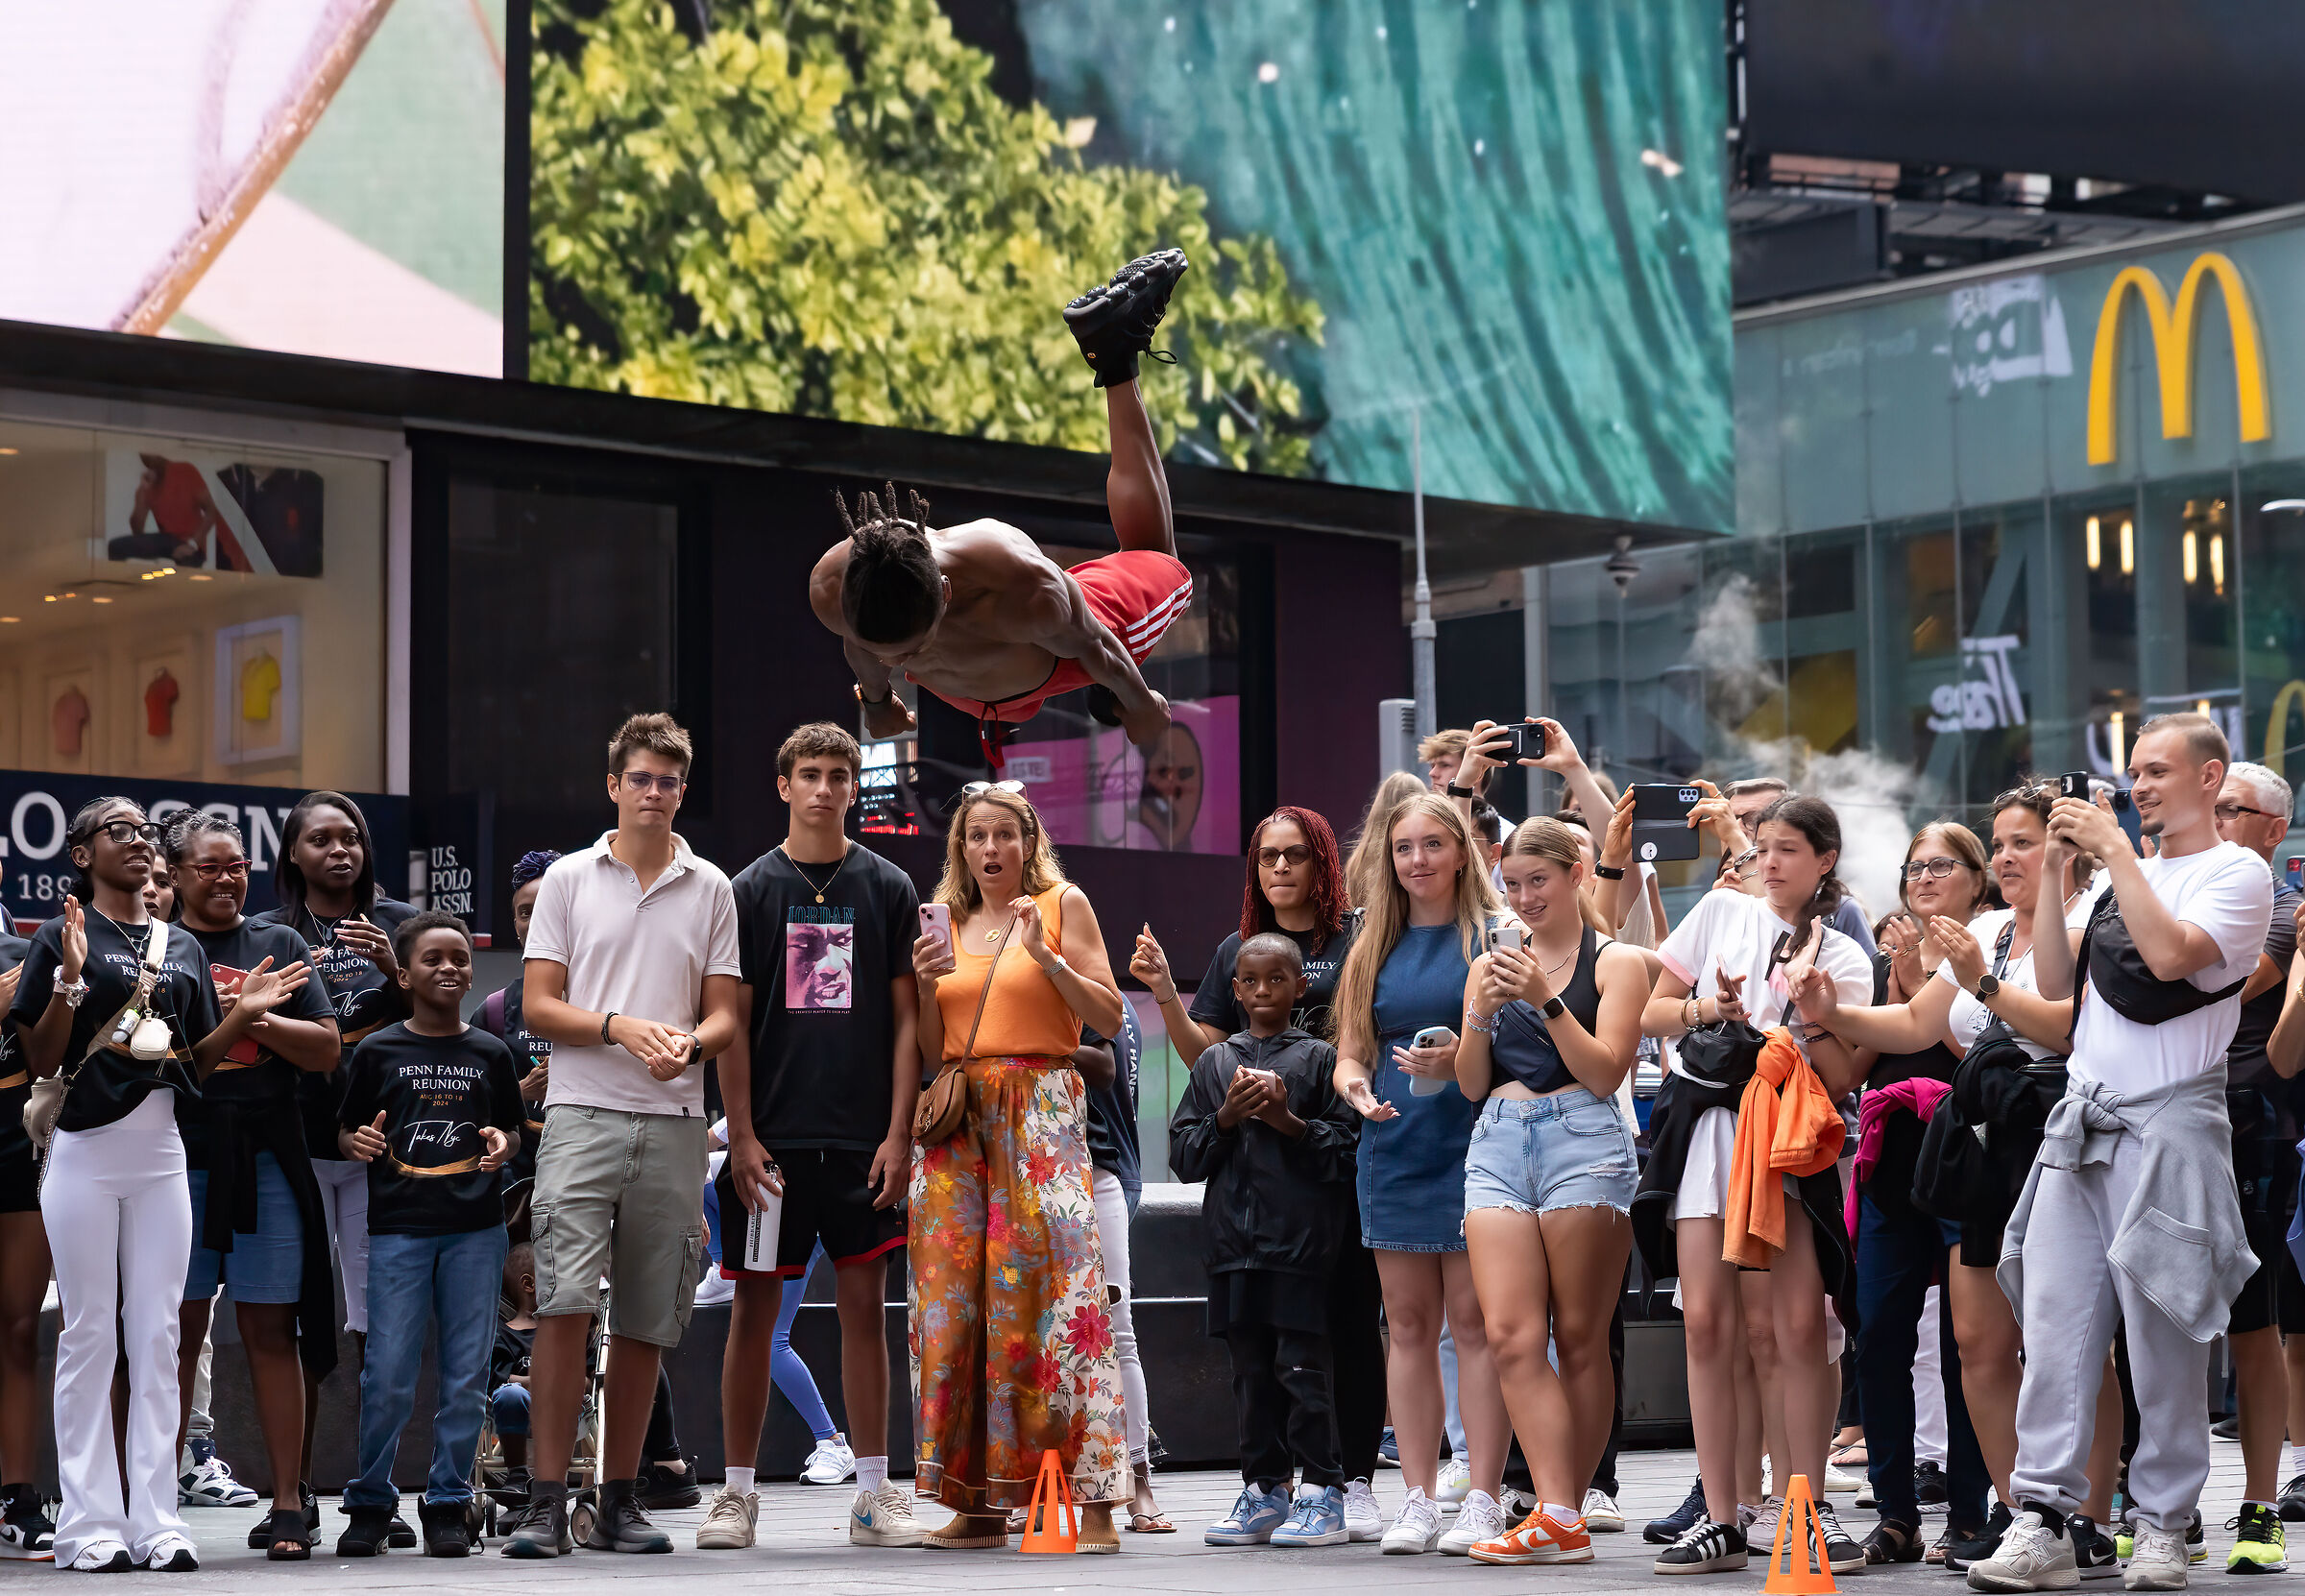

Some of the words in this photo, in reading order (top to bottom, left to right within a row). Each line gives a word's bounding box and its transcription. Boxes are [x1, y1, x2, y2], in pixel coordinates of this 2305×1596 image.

[431, 846, 458, 868] U.S.
[17, 875, 73, 901] 189
[431, 867, 472, 892] POLO
[431, 892, 474, 914] ASSN.
[323, 957, 369, 972] EUNION
[1122, 1002, 1136, 1044] ELLY
[399, 1065, 433, 1076] PENN
[437, 1065, 484, 1079] FAMILY
[412, 1078, 471, 1091] REUNION
[403, 1120, 436, 1152] Takes
